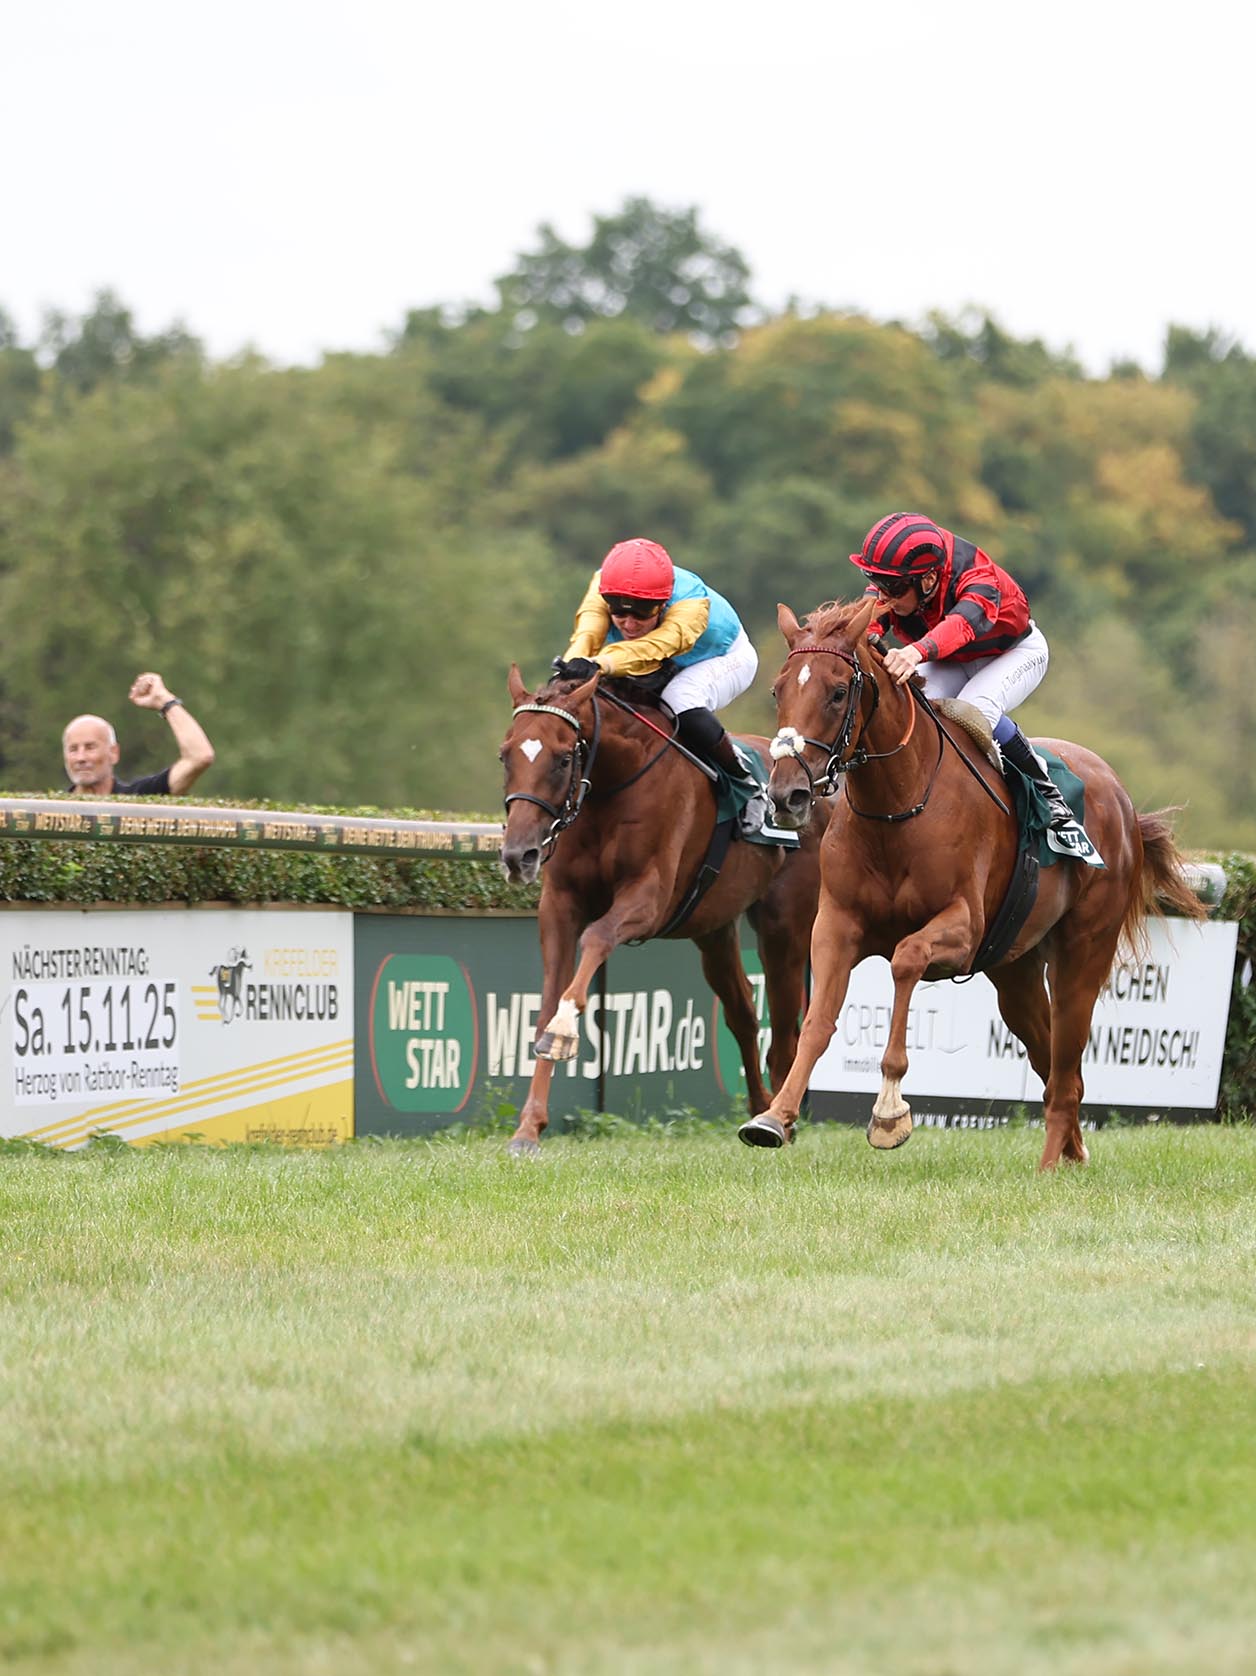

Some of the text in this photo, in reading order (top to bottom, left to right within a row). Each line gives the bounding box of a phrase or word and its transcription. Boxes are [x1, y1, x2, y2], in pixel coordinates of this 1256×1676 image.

[1057, 831, 1079, 843] ETT
[12, 944, 149, 980] NÄCHSTER RENNTAG:
[15, 982, 177, 1056] Sa. 15.11.25
[246, 984, 338, 1020] RENNCLUB
[388, 981, 449, 1030] WETT
[486, 989, 705, 1080] WESTAR.de
[1105, 1026, 1200, 1070] NEIDISCH!
[15, 1060, 178, 1100] Herzog von Ratibor-Renntag
[405, 1038, 460, 1089] STAR
